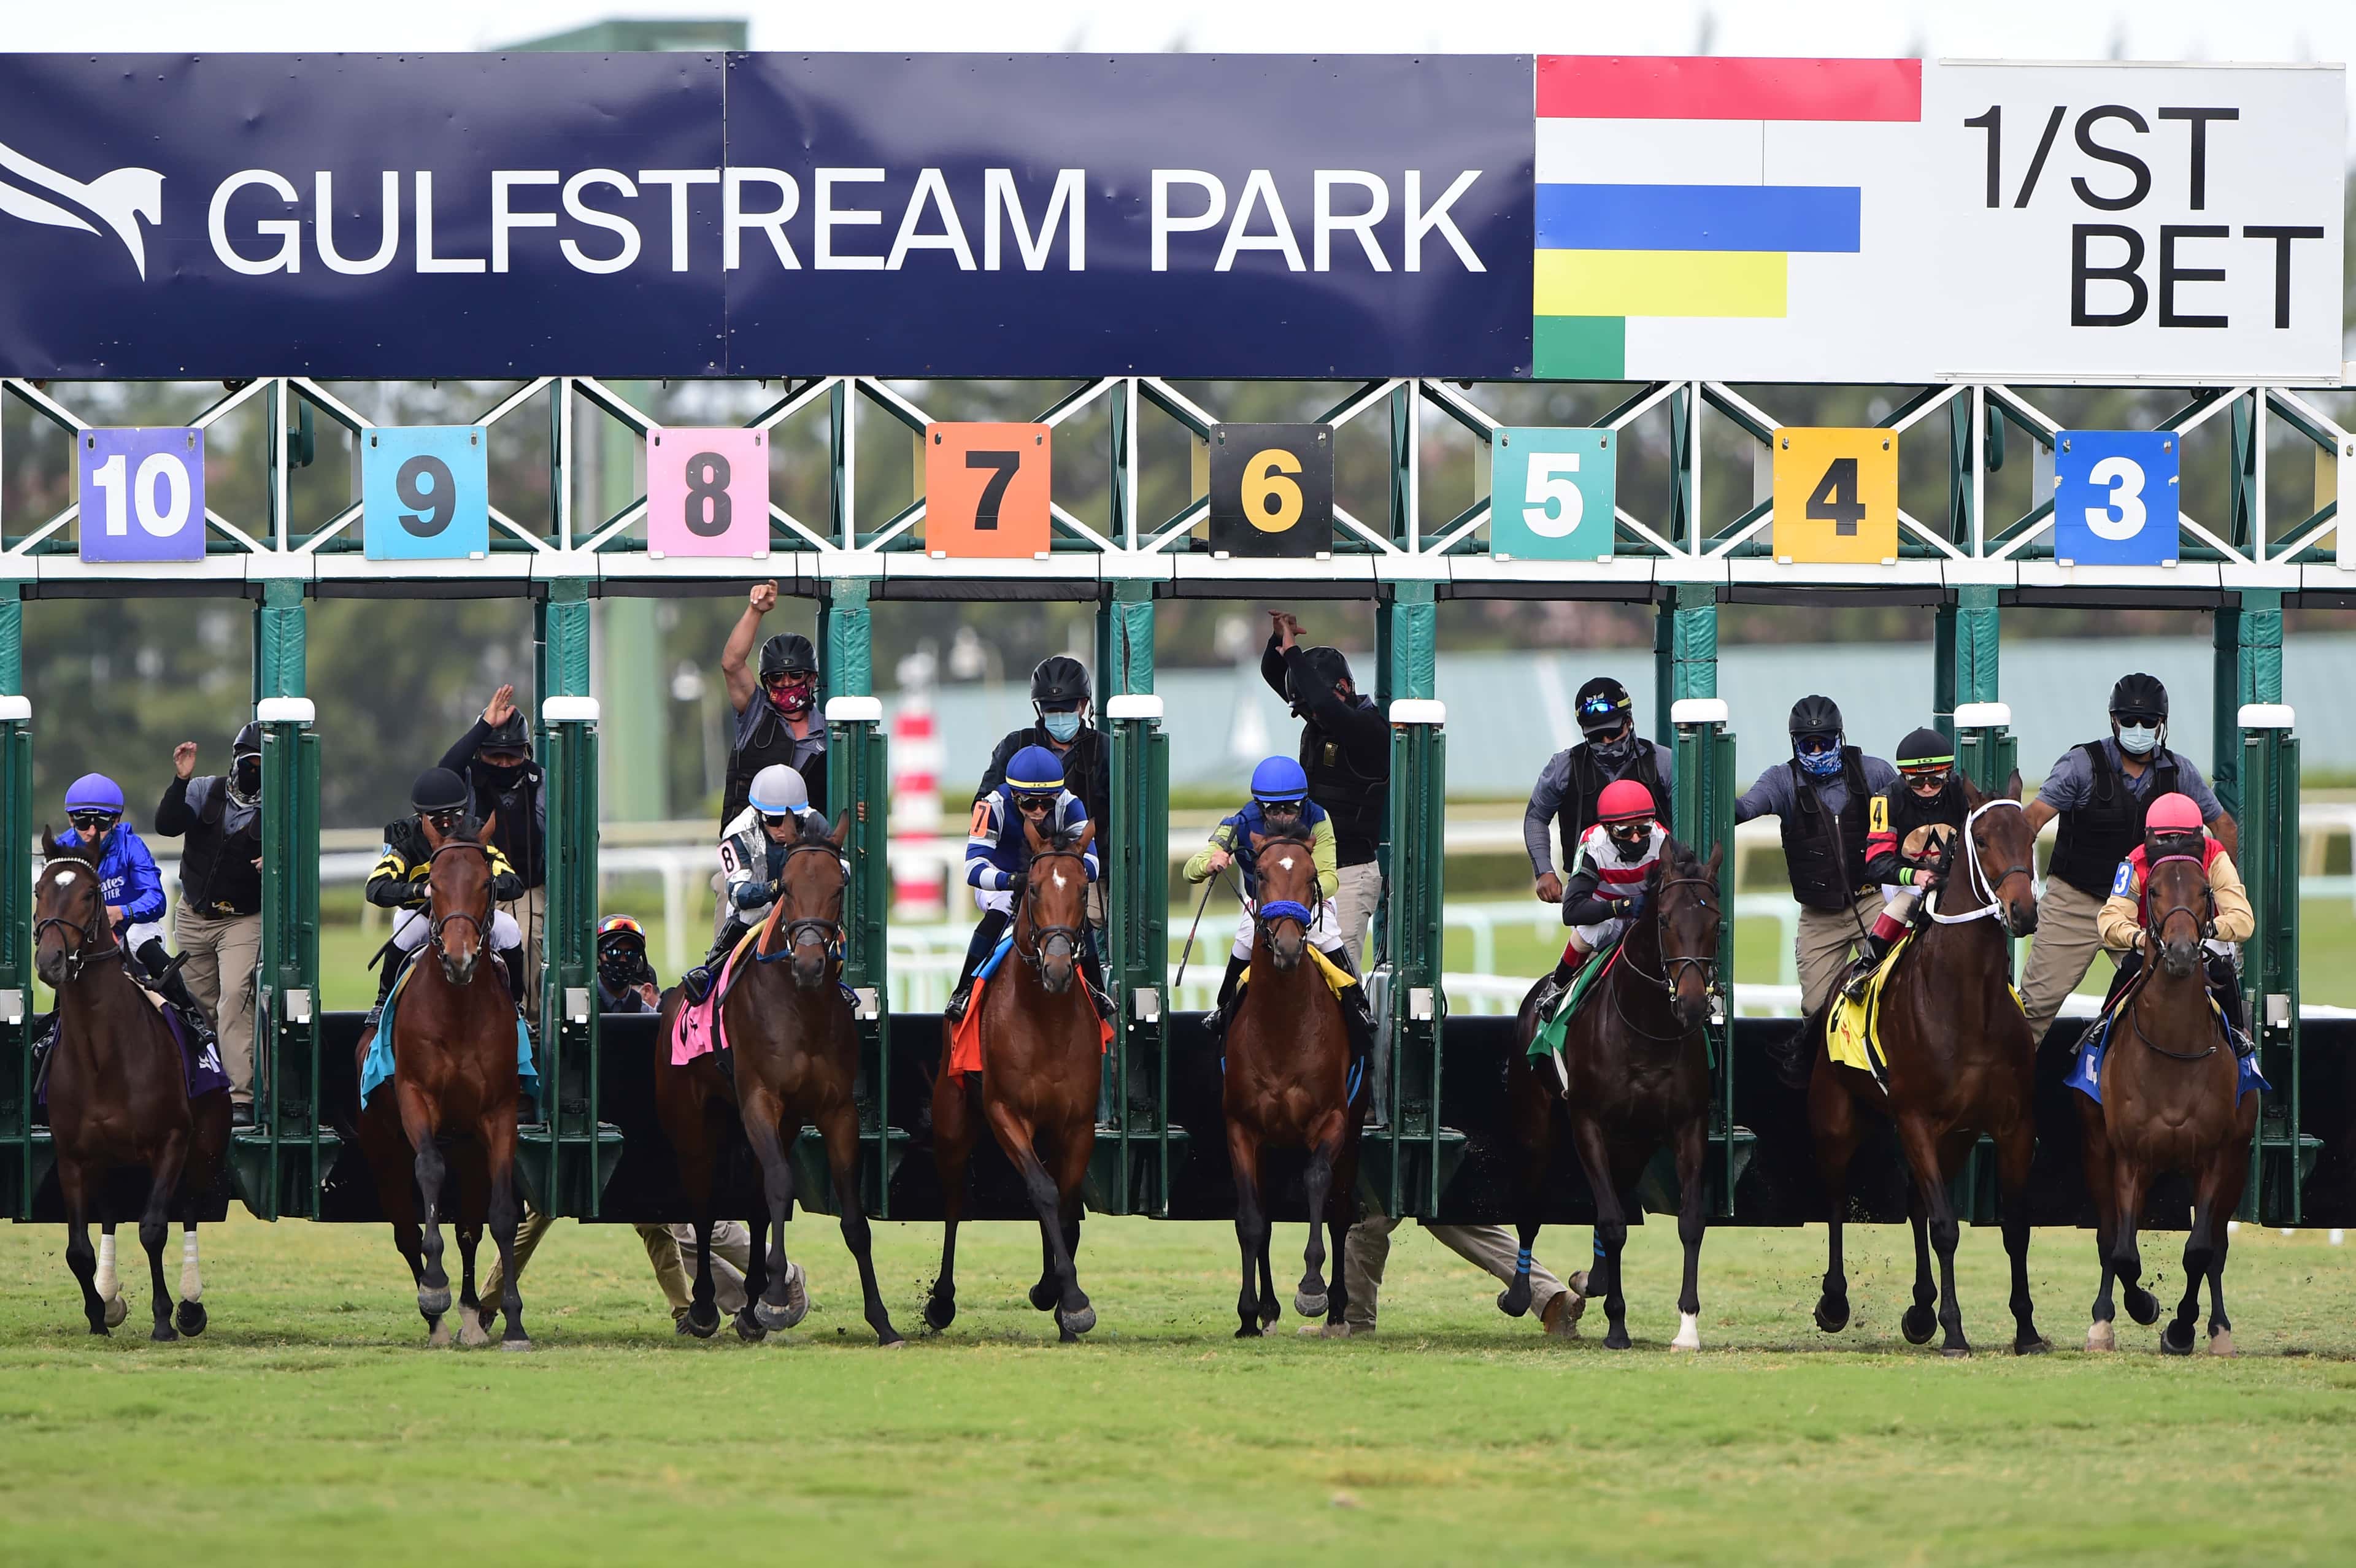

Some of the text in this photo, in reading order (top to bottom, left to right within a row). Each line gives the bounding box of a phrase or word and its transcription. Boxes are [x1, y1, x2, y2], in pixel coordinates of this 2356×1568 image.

[1965, 106, 2239, 210] 1/ST
[209, 167, 1487, 275] GULFSTREAM PARK
[2071, 224, 2324, 328] BET
[93, 453, 191, 537] 10
[395, 454, 456, 537] 9
[684, 452, 732, 537] 8
[965, 450, 1020, 531] 7
[1241, 448, 1303, 533] 6
[1522, 452, 1584, 538] 5
[1806, 458, 1866, 536] 4
[2085, 457, 2146, 540] 3
[974, 805, 987, 832] 7
[1873, 801, 1882, 829] 4
[101, 875, 125, 893] ates
[103, 888, 121, 901] TTER
[722, 847, 734, 873] 8
[2114, 865, 2130, 893] 3
